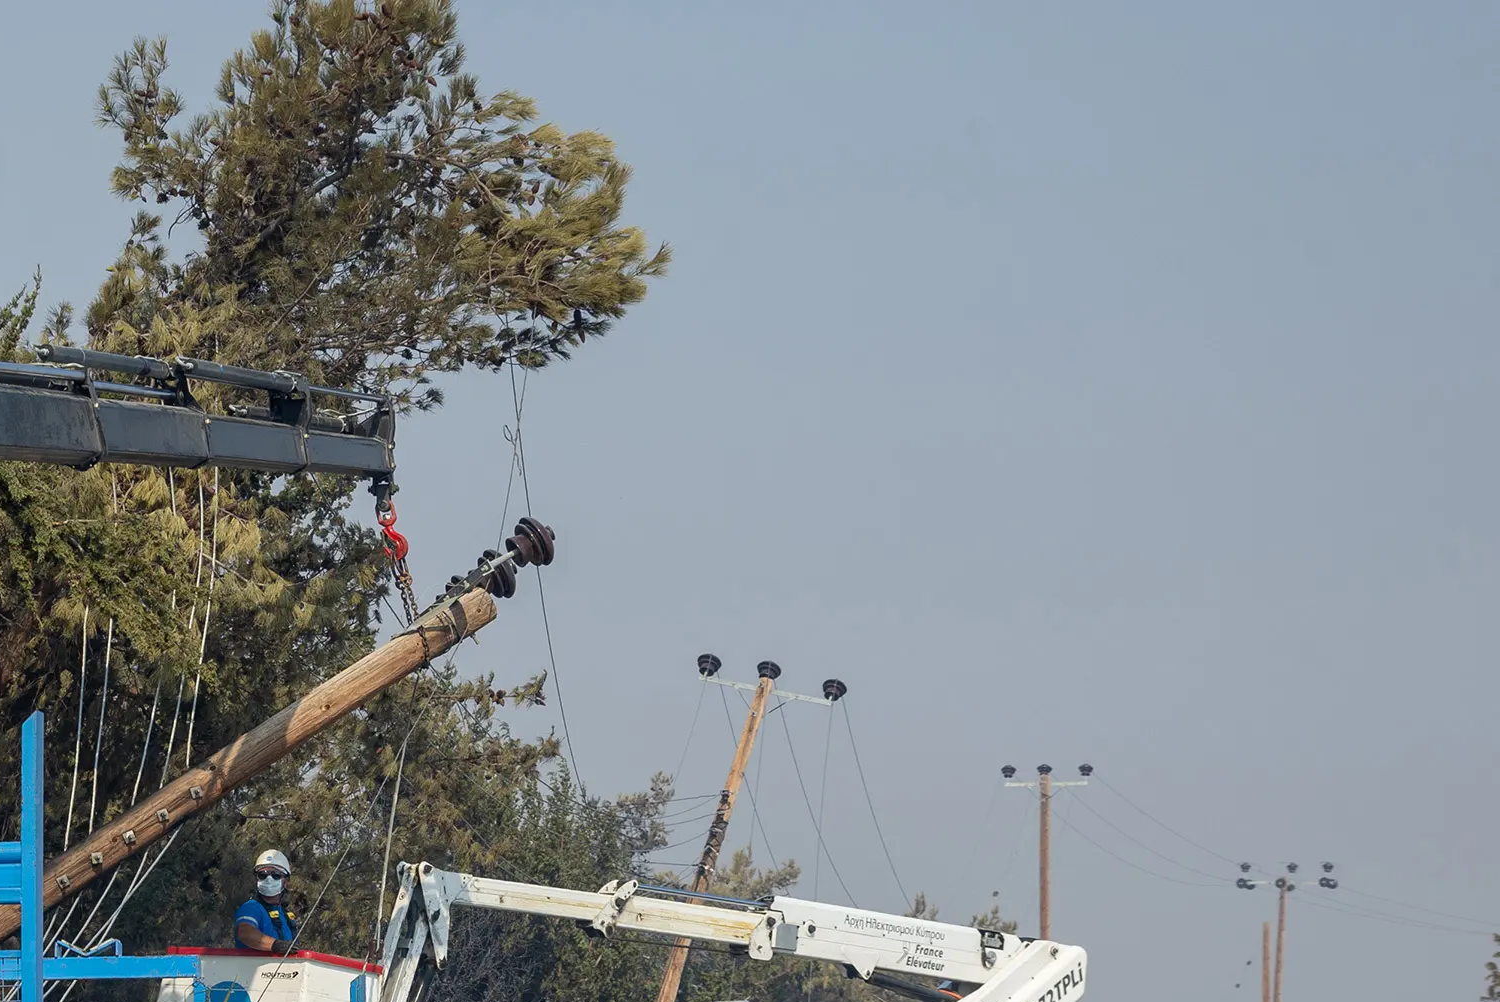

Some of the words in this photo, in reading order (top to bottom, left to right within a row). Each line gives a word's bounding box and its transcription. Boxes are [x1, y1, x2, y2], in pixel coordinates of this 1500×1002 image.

[844, 914, 864, 930] Αρχή
[915, 926, 945, 941] Κύπρου
[915, 944, 944, 958] France
